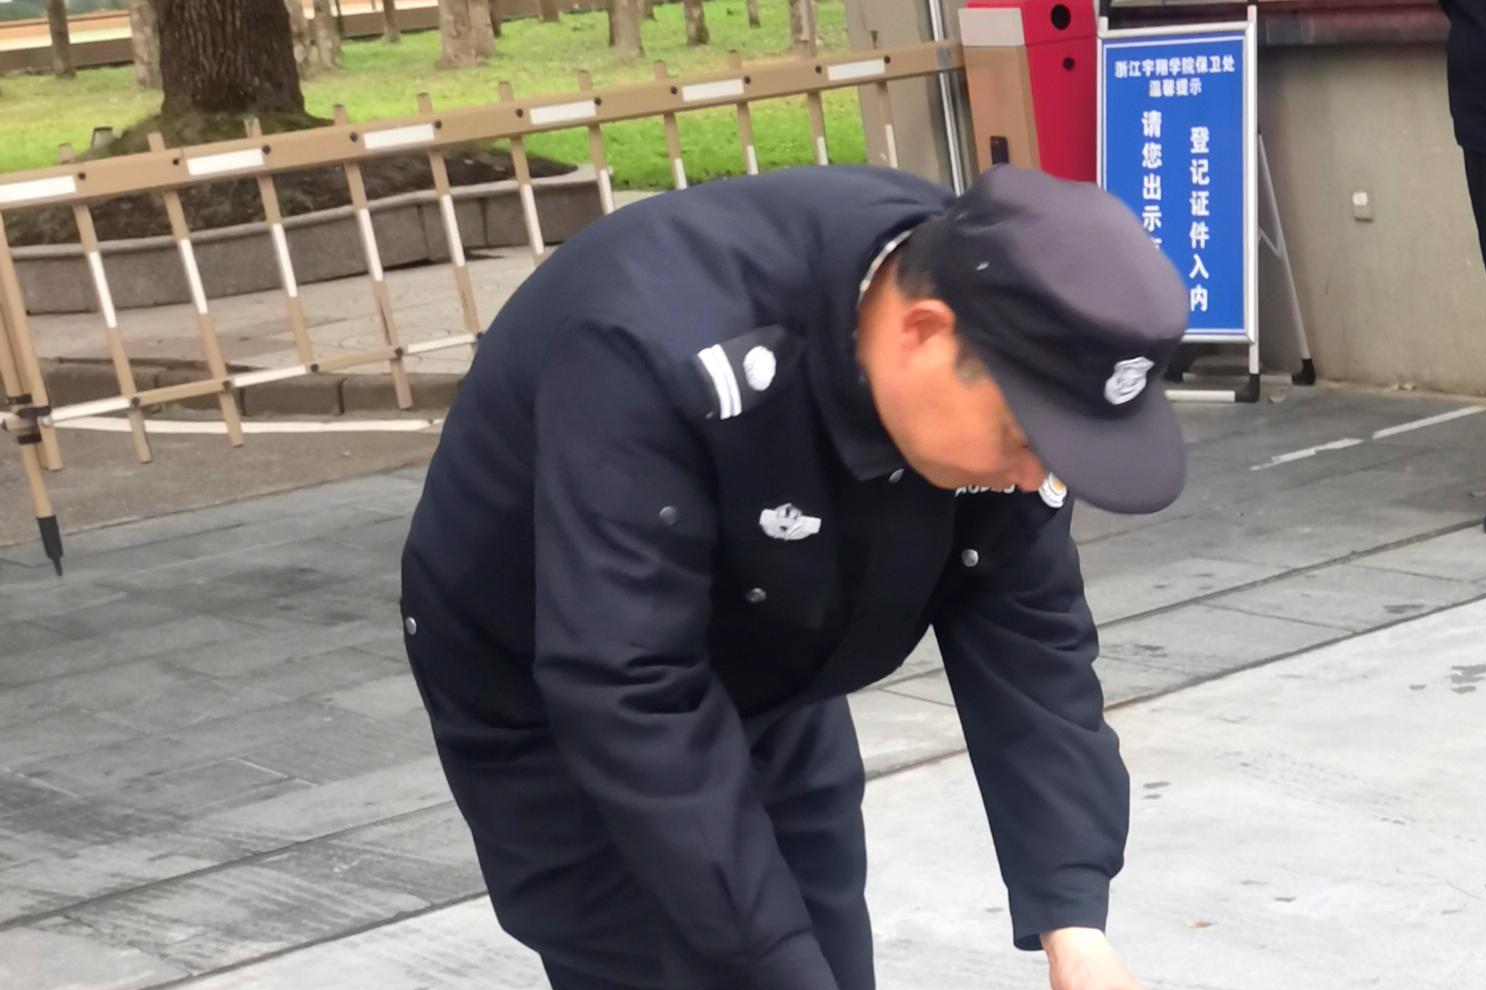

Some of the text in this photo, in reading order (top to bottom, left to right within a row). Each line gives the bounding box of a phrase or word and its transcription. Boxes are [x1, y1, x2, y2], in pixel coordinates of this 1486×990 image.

[1149, 77, 1202, 97] 温馨提示
[1141, 111, 1163, 251] 请您出示
[1189, 126, 1210, 312] 登记证件入内
